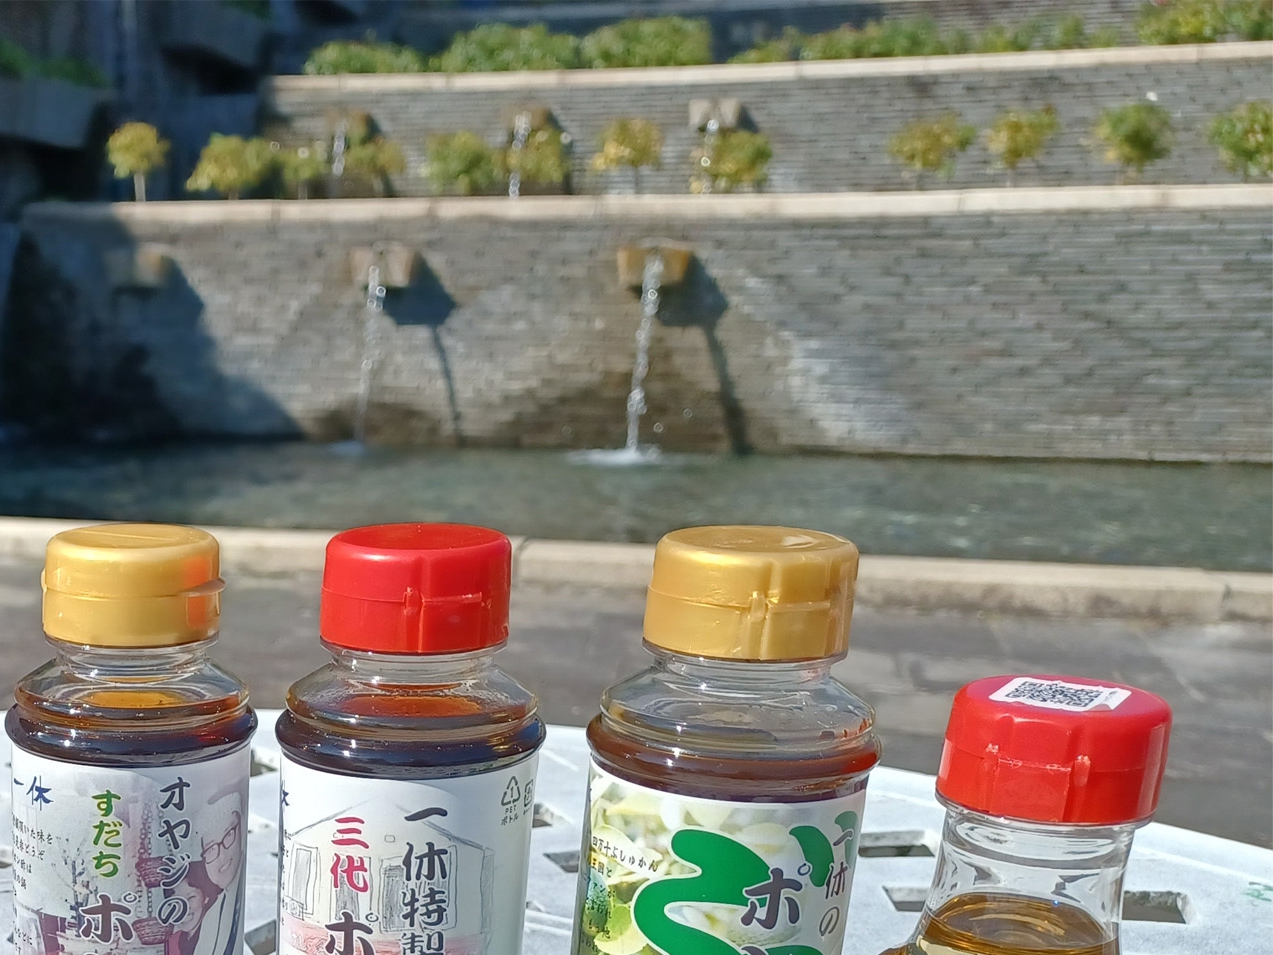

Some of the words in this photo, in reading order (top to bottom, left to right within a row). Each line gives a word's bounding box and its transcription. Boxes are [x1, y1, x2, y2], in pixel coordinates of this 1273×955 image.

[13, 776, 53, 811] 一休
[92, 790, 123, 877] すだち
[157, 776, 191, 925] オヤジの
[818, 828, 854, 937] 一休の
